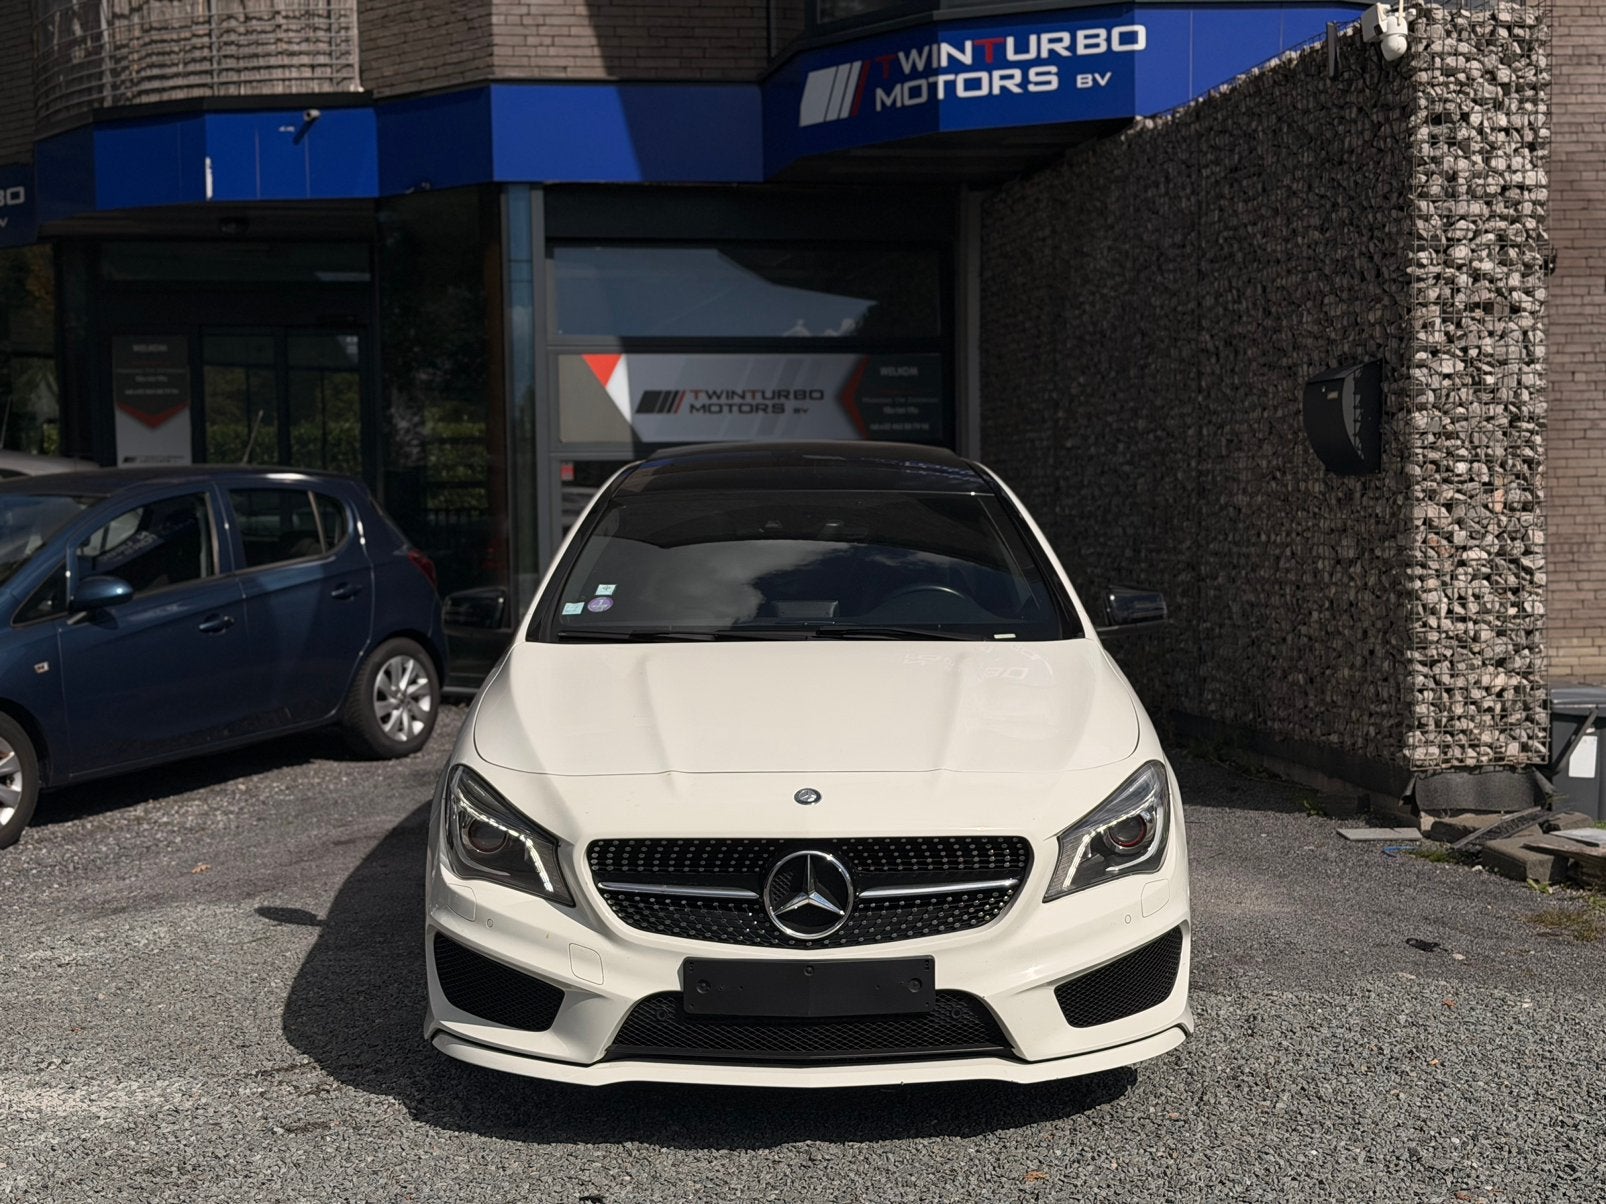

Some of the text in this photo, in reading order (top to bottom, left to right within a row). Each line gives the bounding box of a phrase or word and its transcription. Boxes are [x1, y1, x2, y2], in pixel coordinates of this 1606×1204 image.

[873, 24, 1147, 80] TWINTURBO
[875, 65, 1112, 112] MOTORS BV
[689, 389, 825, 401] TWINTURBO
[689, 403, 785, 414] MOTORS
